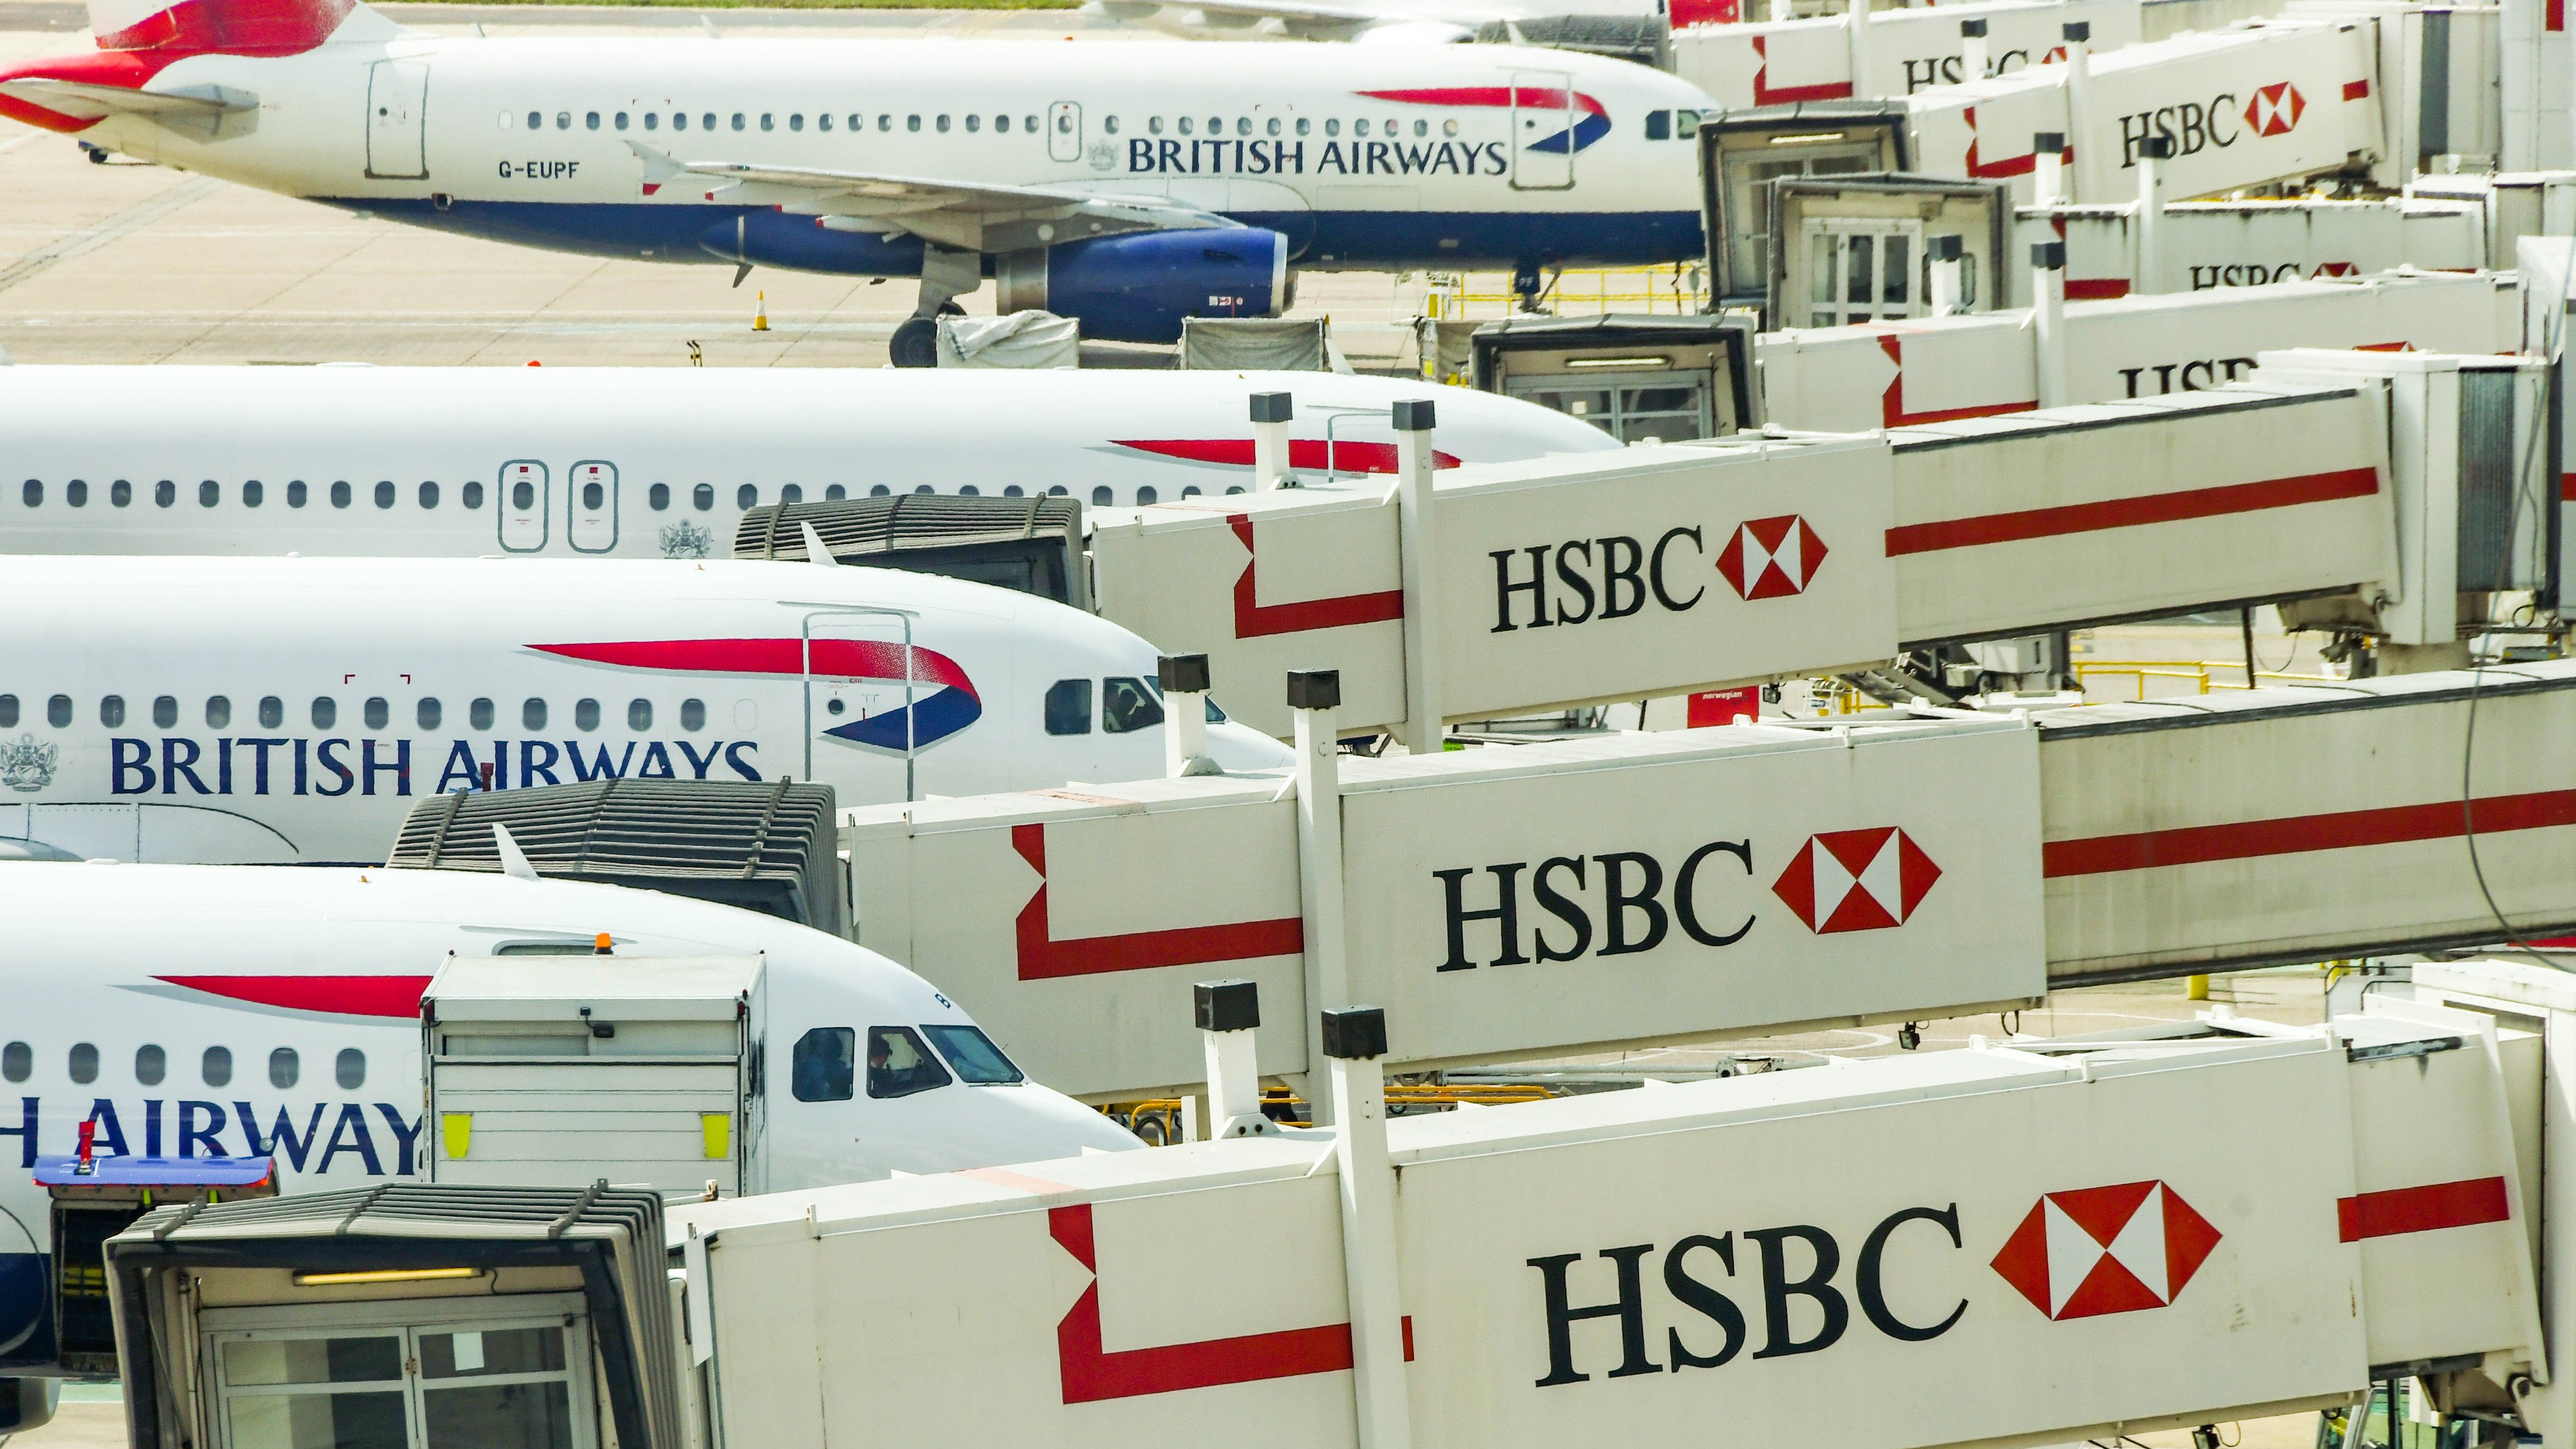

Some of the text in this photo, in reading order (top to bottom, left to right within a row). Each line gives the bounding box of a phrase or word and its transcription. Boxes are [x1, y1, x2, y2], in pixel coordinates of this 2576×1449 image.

[1129, 139, 1507, 176] BRITISH AIRWAYS
[2119, 93, 2239, 168] HSBC
[499, 161, 579, 179] G-EUPF
[1488, 525, 1705, 633] HSBC
[1703, 691, 1742, 700] norwegian
[111, 738, 763, 796] BRITISH AIRWAYS
[1432, 839, 1756, 972] HSBC
[74, 1098, 423, 1176] AIRWAY
[1526, 1202, 1969, 1388] HSBC
